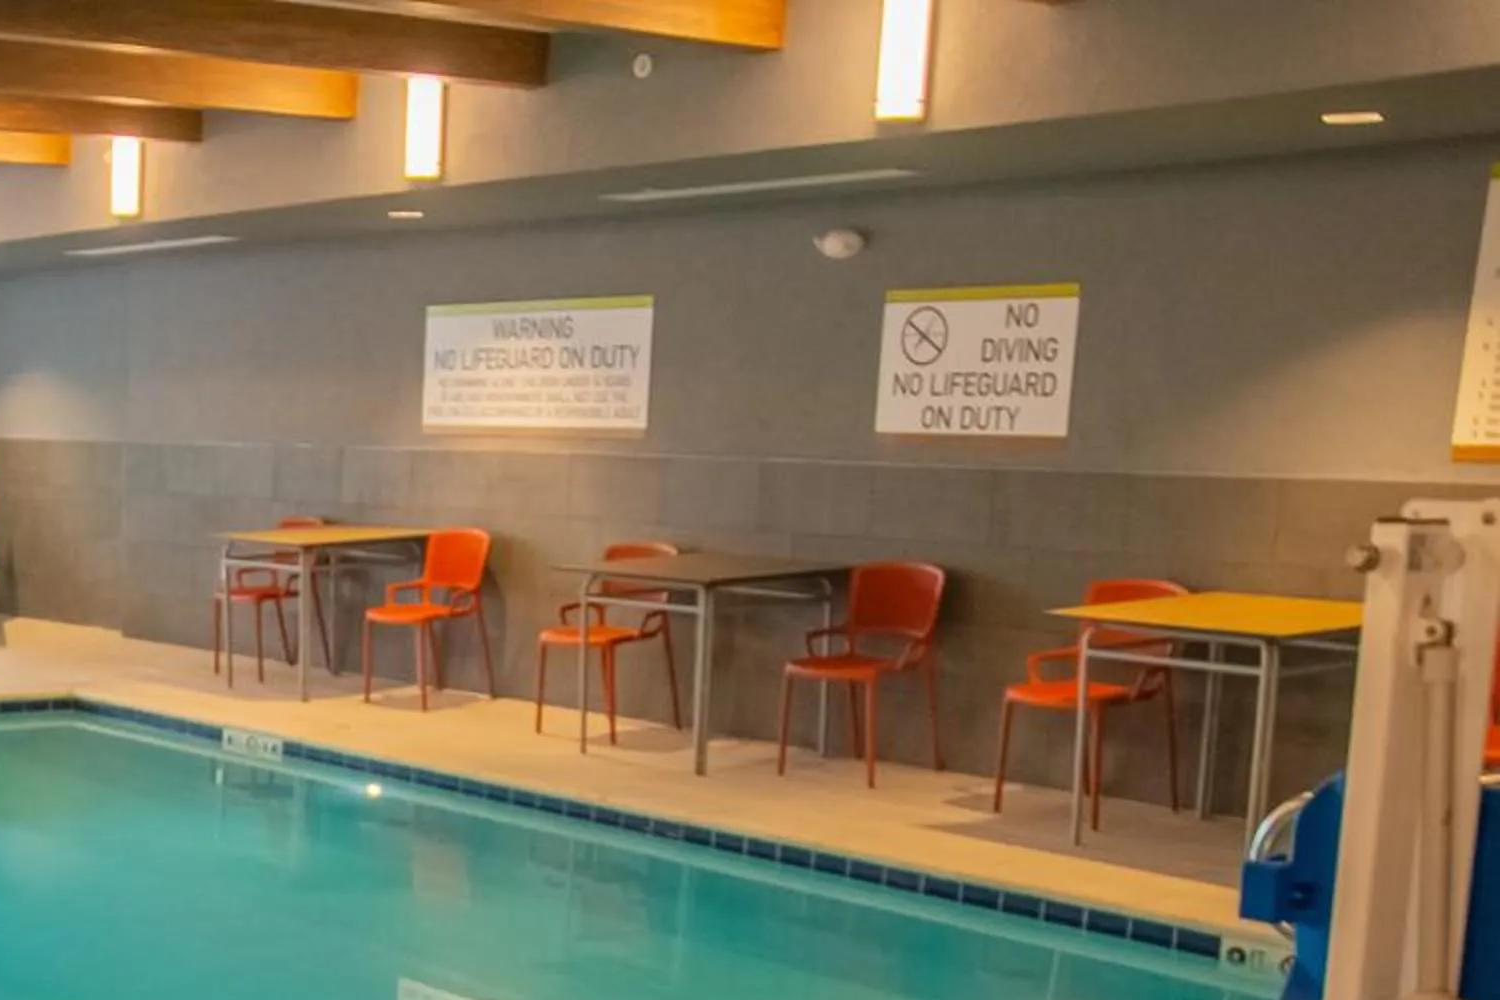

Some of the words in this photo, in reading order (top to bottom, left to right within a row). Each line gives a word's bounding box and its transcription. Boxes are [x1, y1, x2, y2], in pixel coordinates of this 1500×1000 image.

[492, 315, 575, 340] WARNING
[1005, 303, 1039, 328] NO
[434, 349, 457, 371] NO
[461, 346, 553, 370] LIFEGUARD
[558, 346, 584, 369] ON
[591, 344, 641, 369] DUTY
[980, 337, 1059, 362] DIVING
[892, 372, 923, 396] NO
[930, 372, 1058, 397] LIFEGUARD
[920, 405, 952, 429] ON
[959, 405, 1020, 431] DUTY
